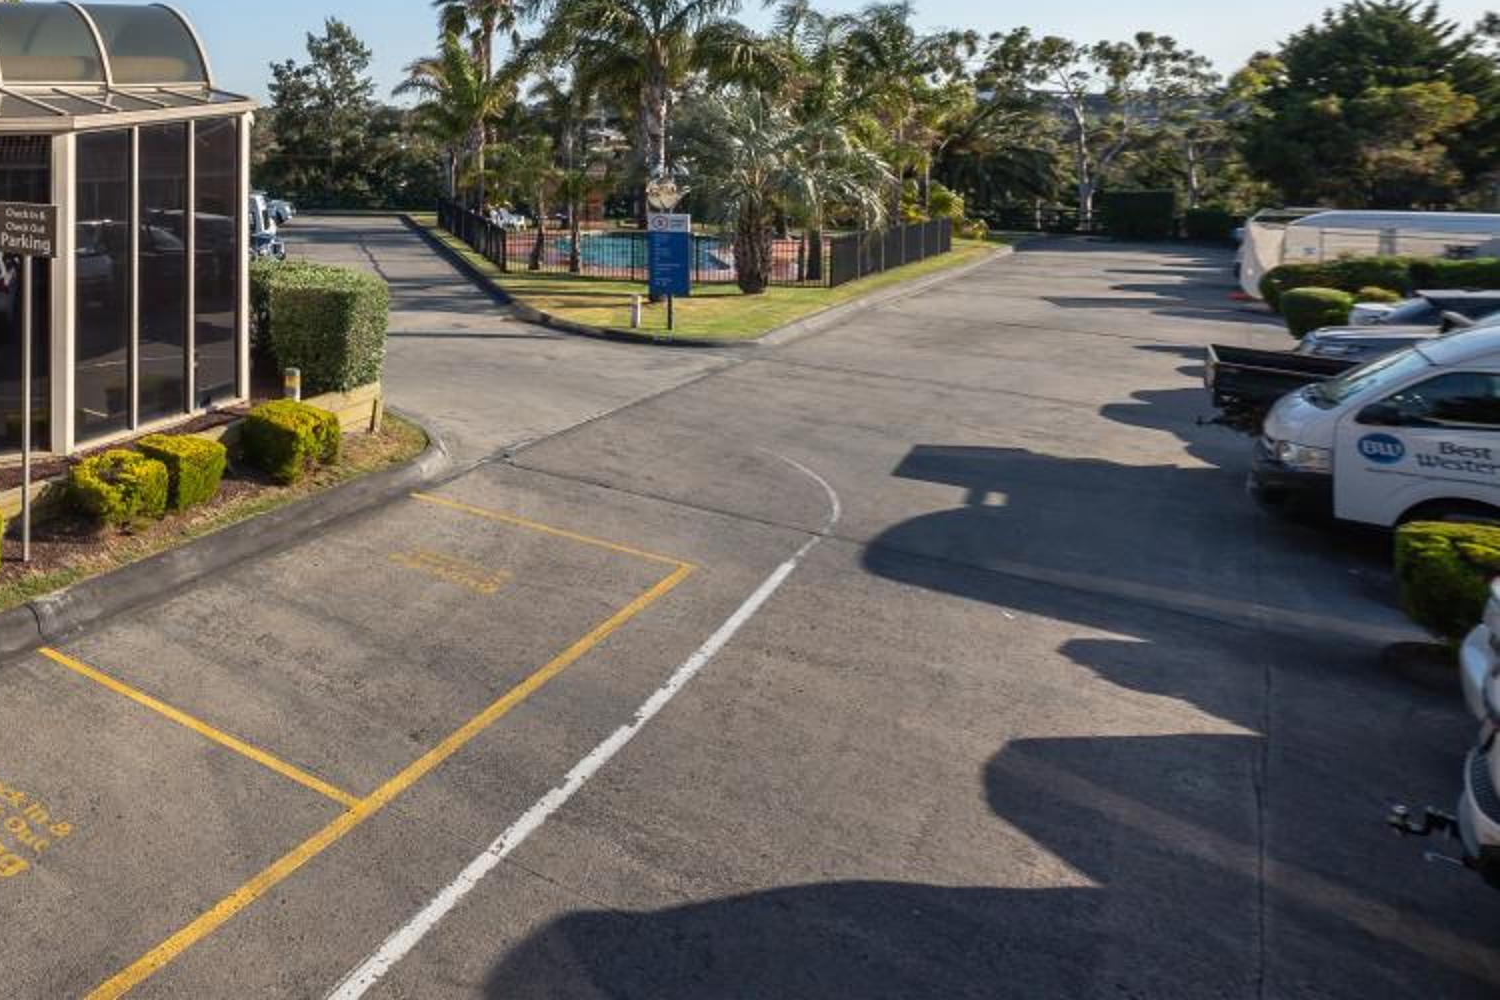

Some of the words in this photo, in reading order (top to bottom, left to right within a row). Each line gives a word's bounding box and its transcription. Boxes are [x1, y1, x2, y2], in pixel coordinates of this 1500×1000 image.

[5, 207, 28, 218] Check
[5, 221, 28, 232] Check
[30, 223, 45, 233] Out
[1, 231, 51, 255] Parking
[1438, 441, 1492, 460] Best
